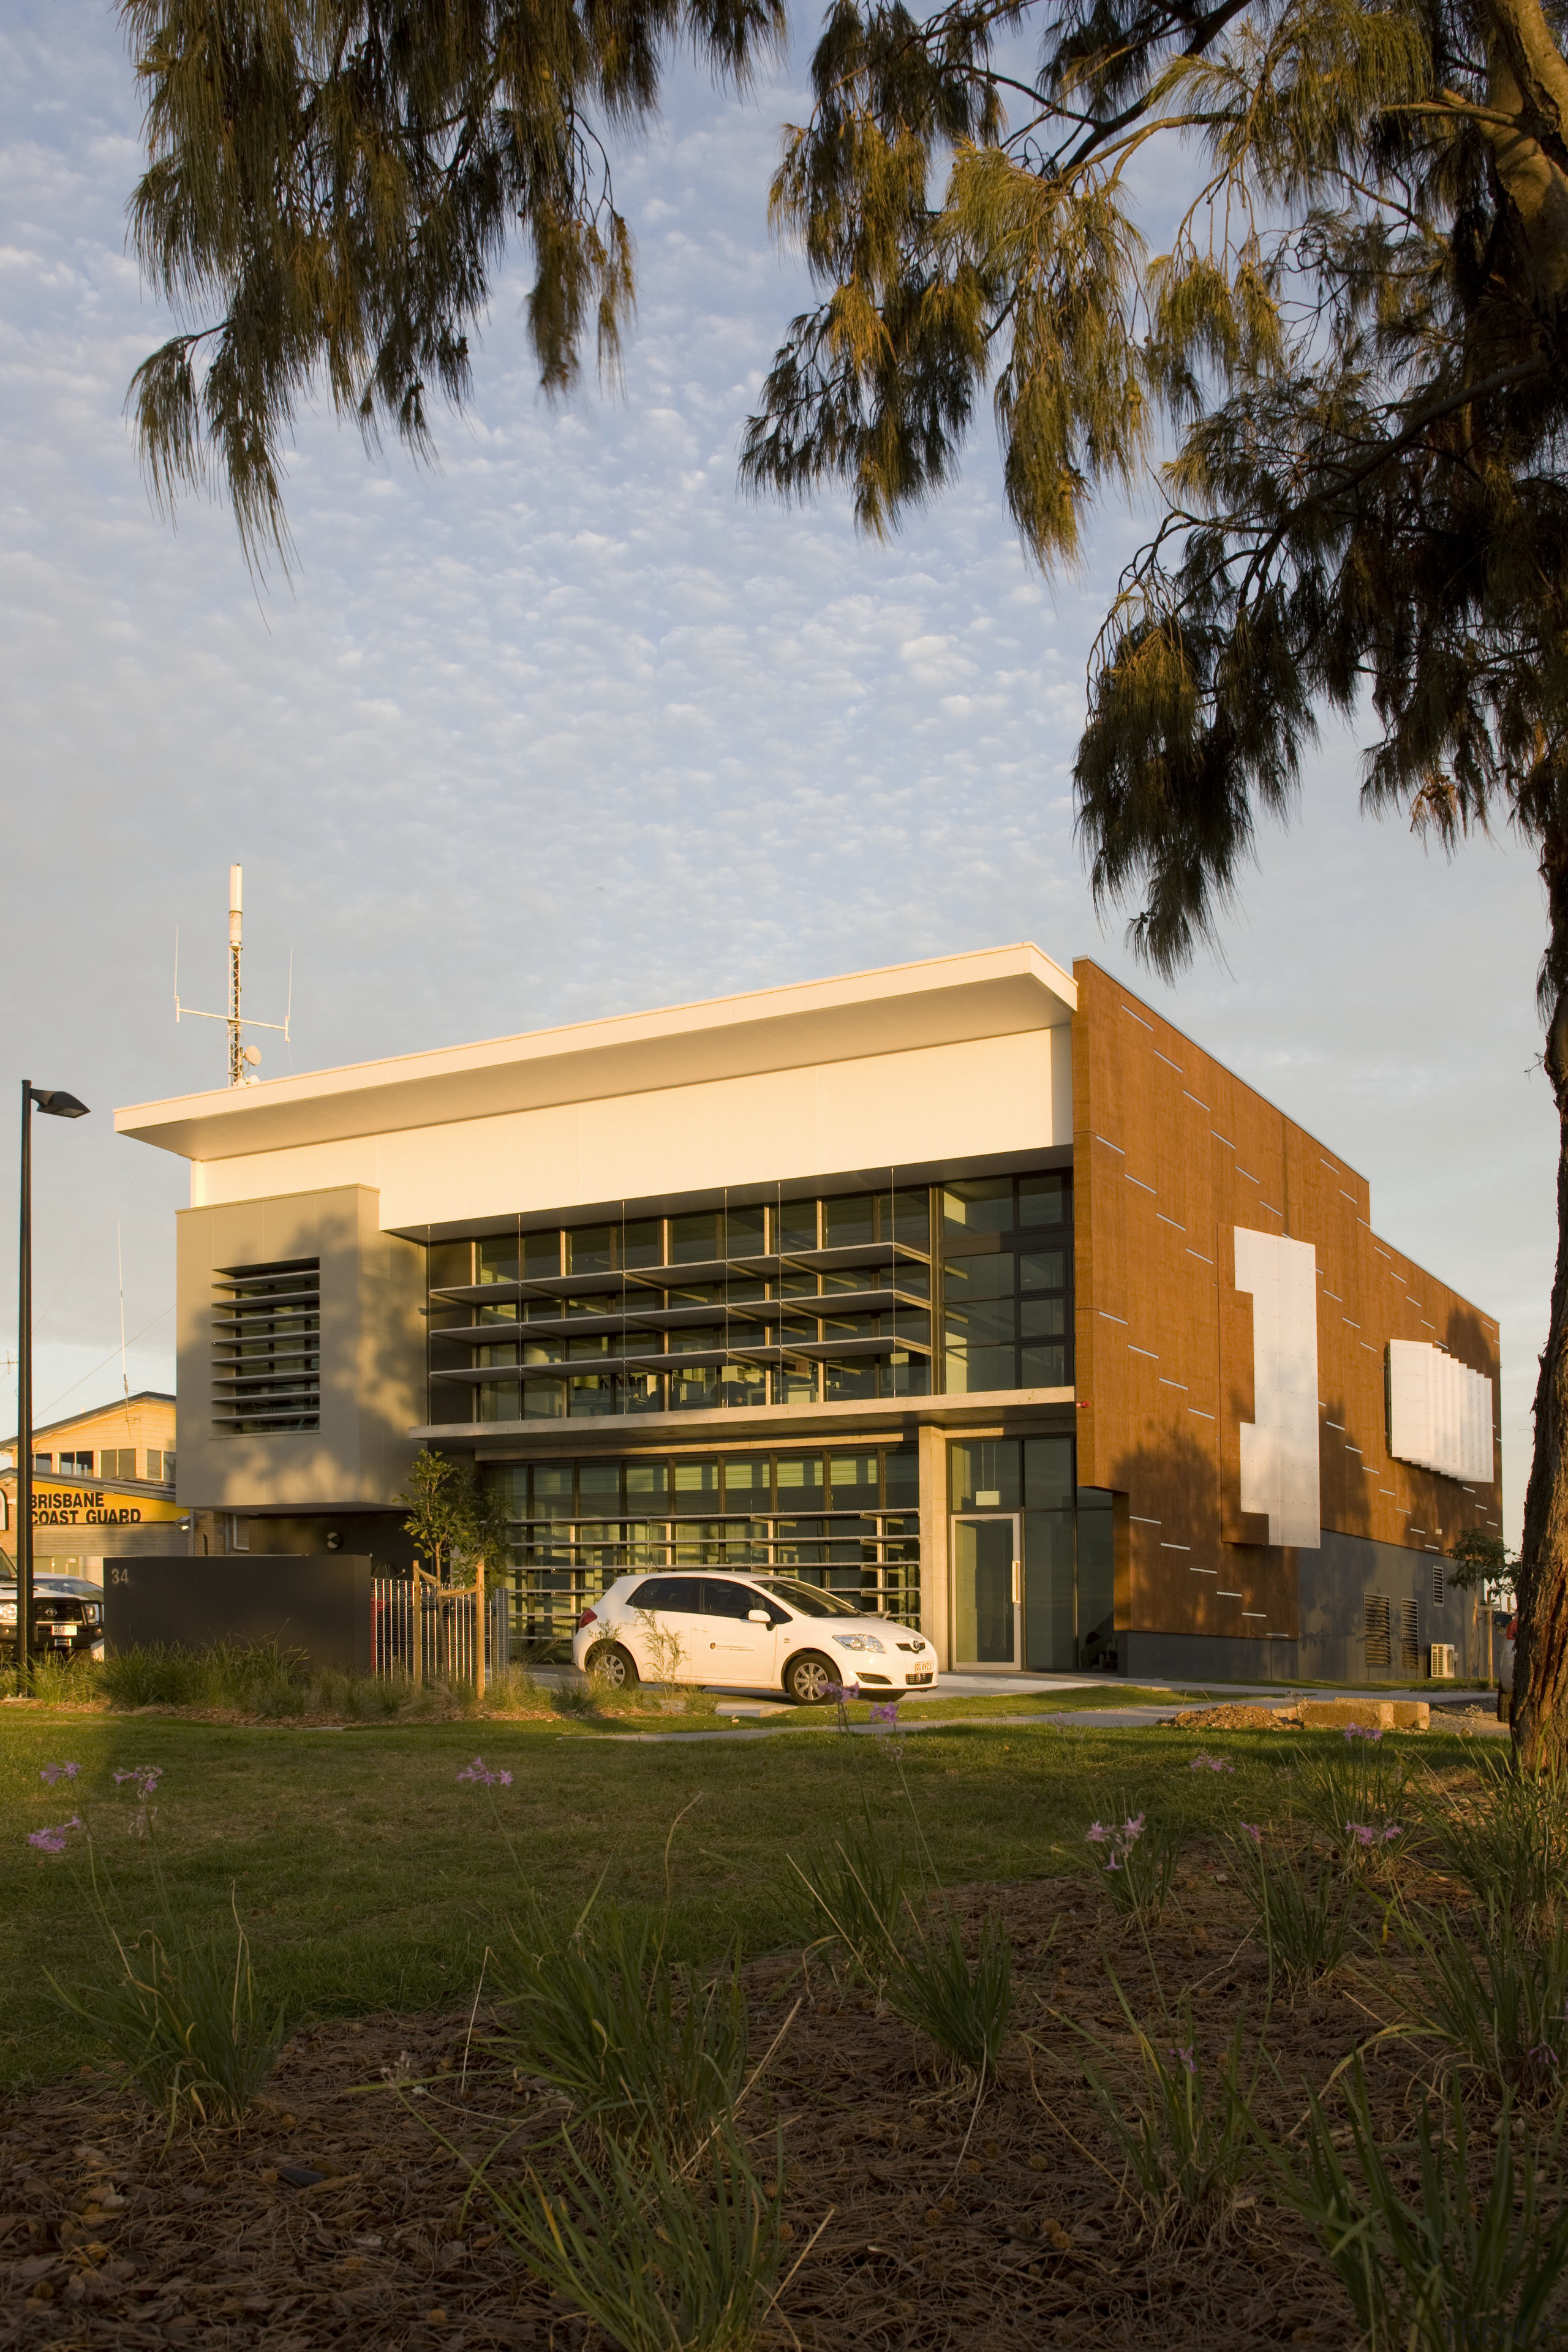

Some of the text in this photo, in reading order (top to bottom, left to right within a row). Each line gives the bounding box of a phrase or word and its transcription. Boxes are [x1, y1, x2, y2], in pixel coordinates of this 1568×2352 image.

[31, 1492, 104, 1509] BRISBANE
[86, 1509, 141, 1523] GUARD
[111, 1568, 129, 1585] 34
